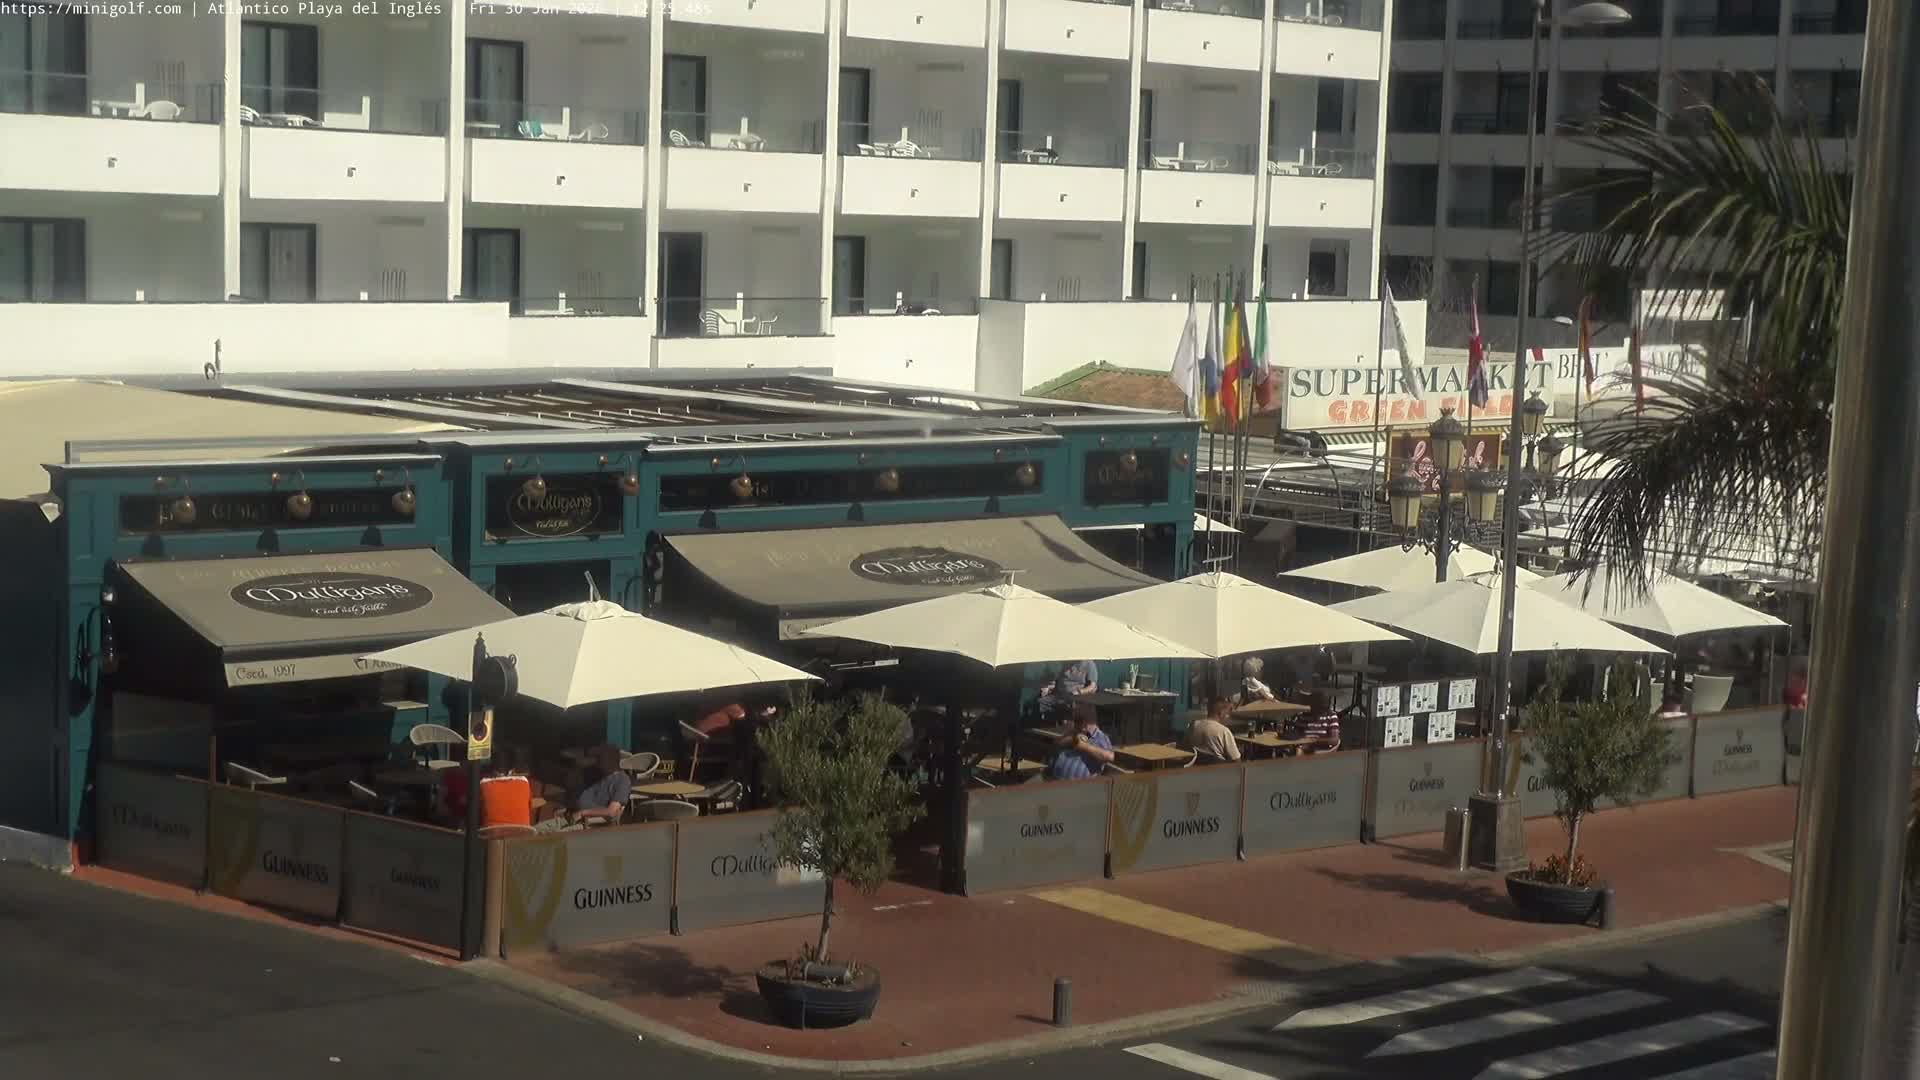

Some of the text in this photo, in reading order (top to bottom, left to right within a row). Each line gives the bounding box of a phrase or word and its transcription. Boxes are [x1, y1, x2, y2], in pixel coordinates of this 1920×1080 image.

[1290, 363, 1552, 397] SUPERMAKT
[246, 583, 409, 601] Mulligan's
[273, 663, 296, 677] 1997
[1020, 822, 1065, 840] GUINNESS
[1163, 815, 1220, 840] GUINNESS
[263, 850, 330, 885] GUINNESS
[573, 883, 653, 911] GUINNESS
